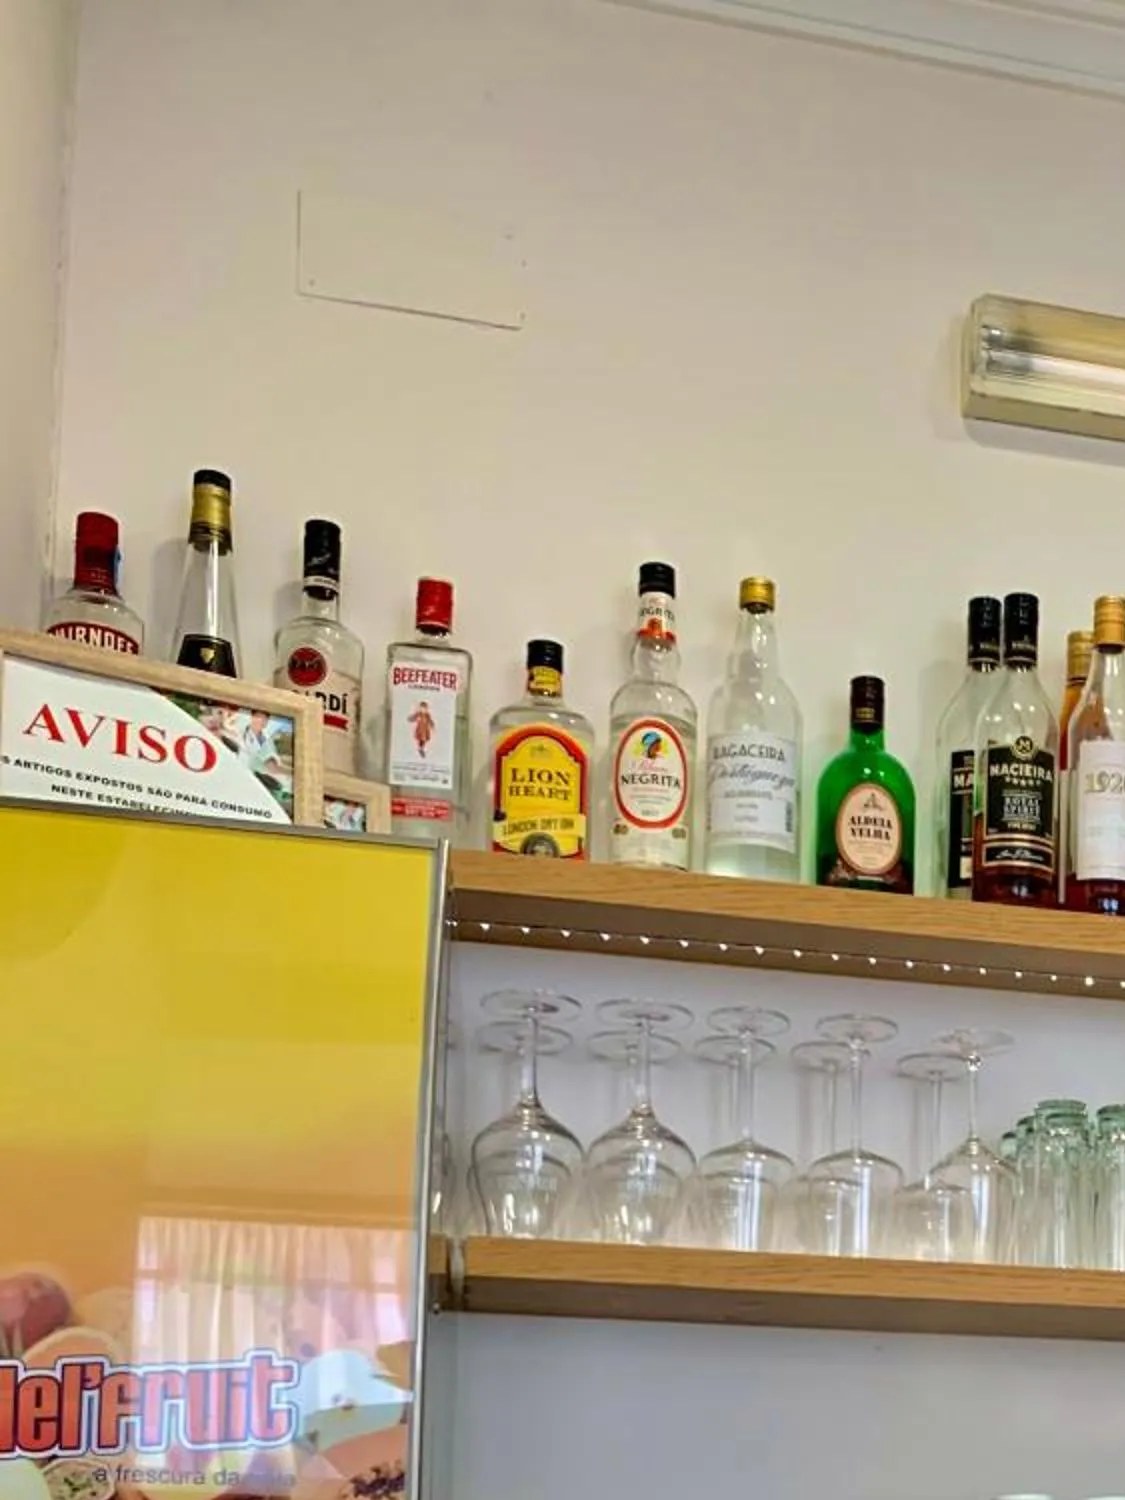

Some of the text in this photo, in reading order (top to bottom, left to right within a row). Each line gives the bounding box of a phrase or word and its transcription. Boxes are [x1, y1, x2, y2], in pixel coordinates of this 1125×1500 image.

[393, 667, 457, 690] BEEFEATER
[22, 703, 218, 773] AVISO
[511, 767, 570, 786] LION
[621, 773, 681, 789] NEGRITA
[989, 763, 1053, 782] MACIEIRA
[13, 758, 73, 779] ARTIGOS
[75, 771, 143, 793] EXPOSTOS
[175, 792, 208, 806] PARA
[210, 798, 273, 819] CONSUMO
[51, 783, 94, 800] NESTE
[508, 785, 570, 801] HEART
[849, 815, 893, 830] ALDEIA
[850, 828, 891, 841] VELHA
[114, 1465, 206, 1486] frescura
[213, 1468, 241, 1486] da
